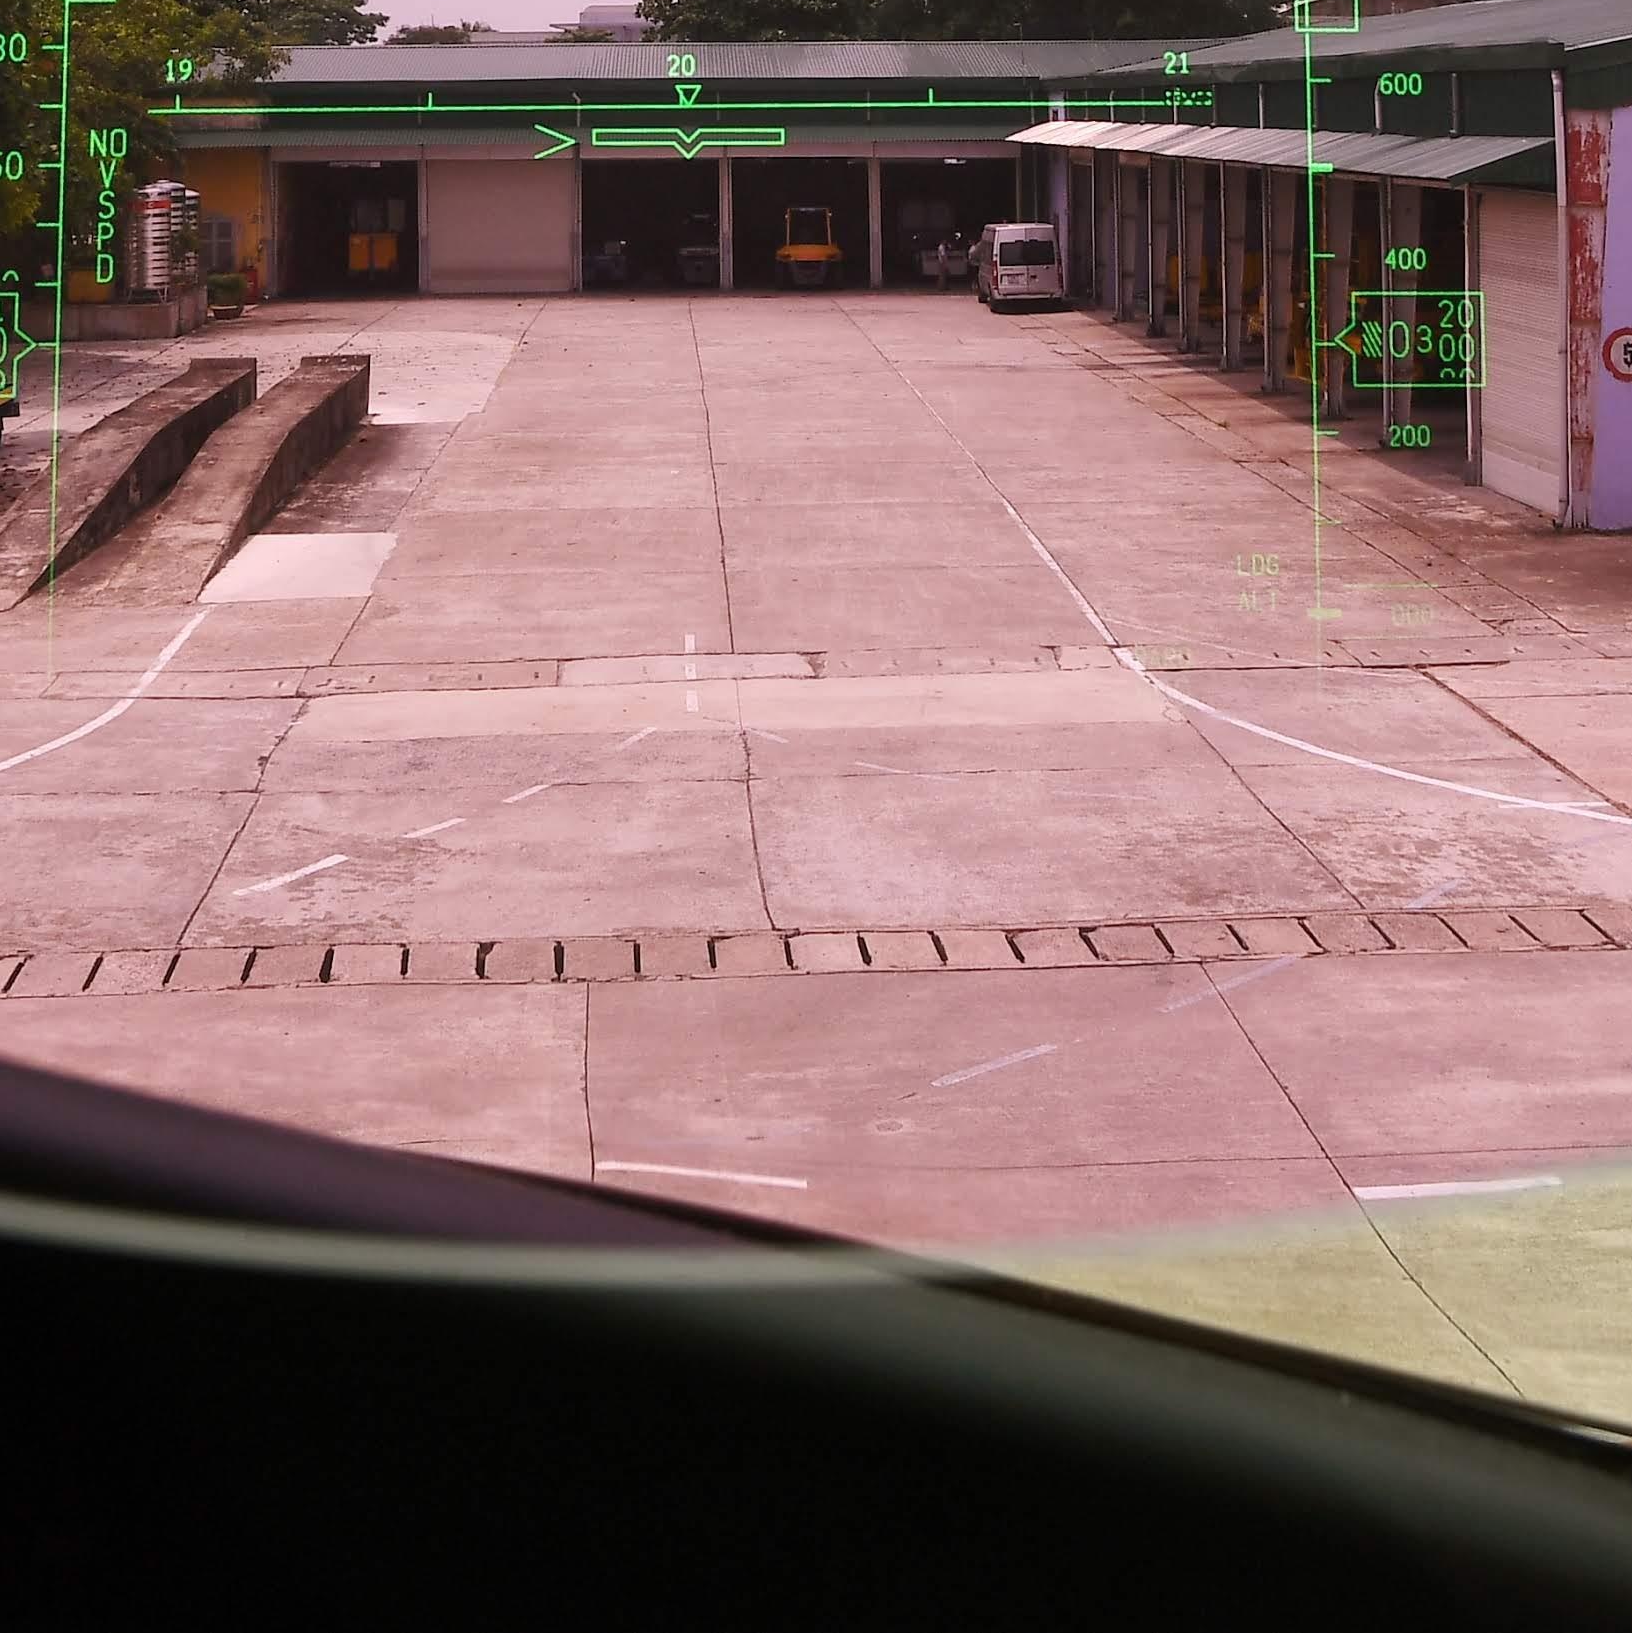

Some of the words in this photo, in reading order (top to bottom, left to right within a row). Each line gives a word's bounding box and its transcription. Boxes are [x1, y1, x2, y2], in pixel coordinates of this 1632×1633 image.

[165, 58, 194, 81] 19
[667, 55, 696, 77] 20
[1163, 52, 1190, 74] 21
[1379, 72, 1423, 96] 600
[89, 128, 128, 158] NO
[1385, 248, 1427, 270] 400
[1388, 424, 1431, 448] 200
[1235, 553, 1279, 577] LDG
